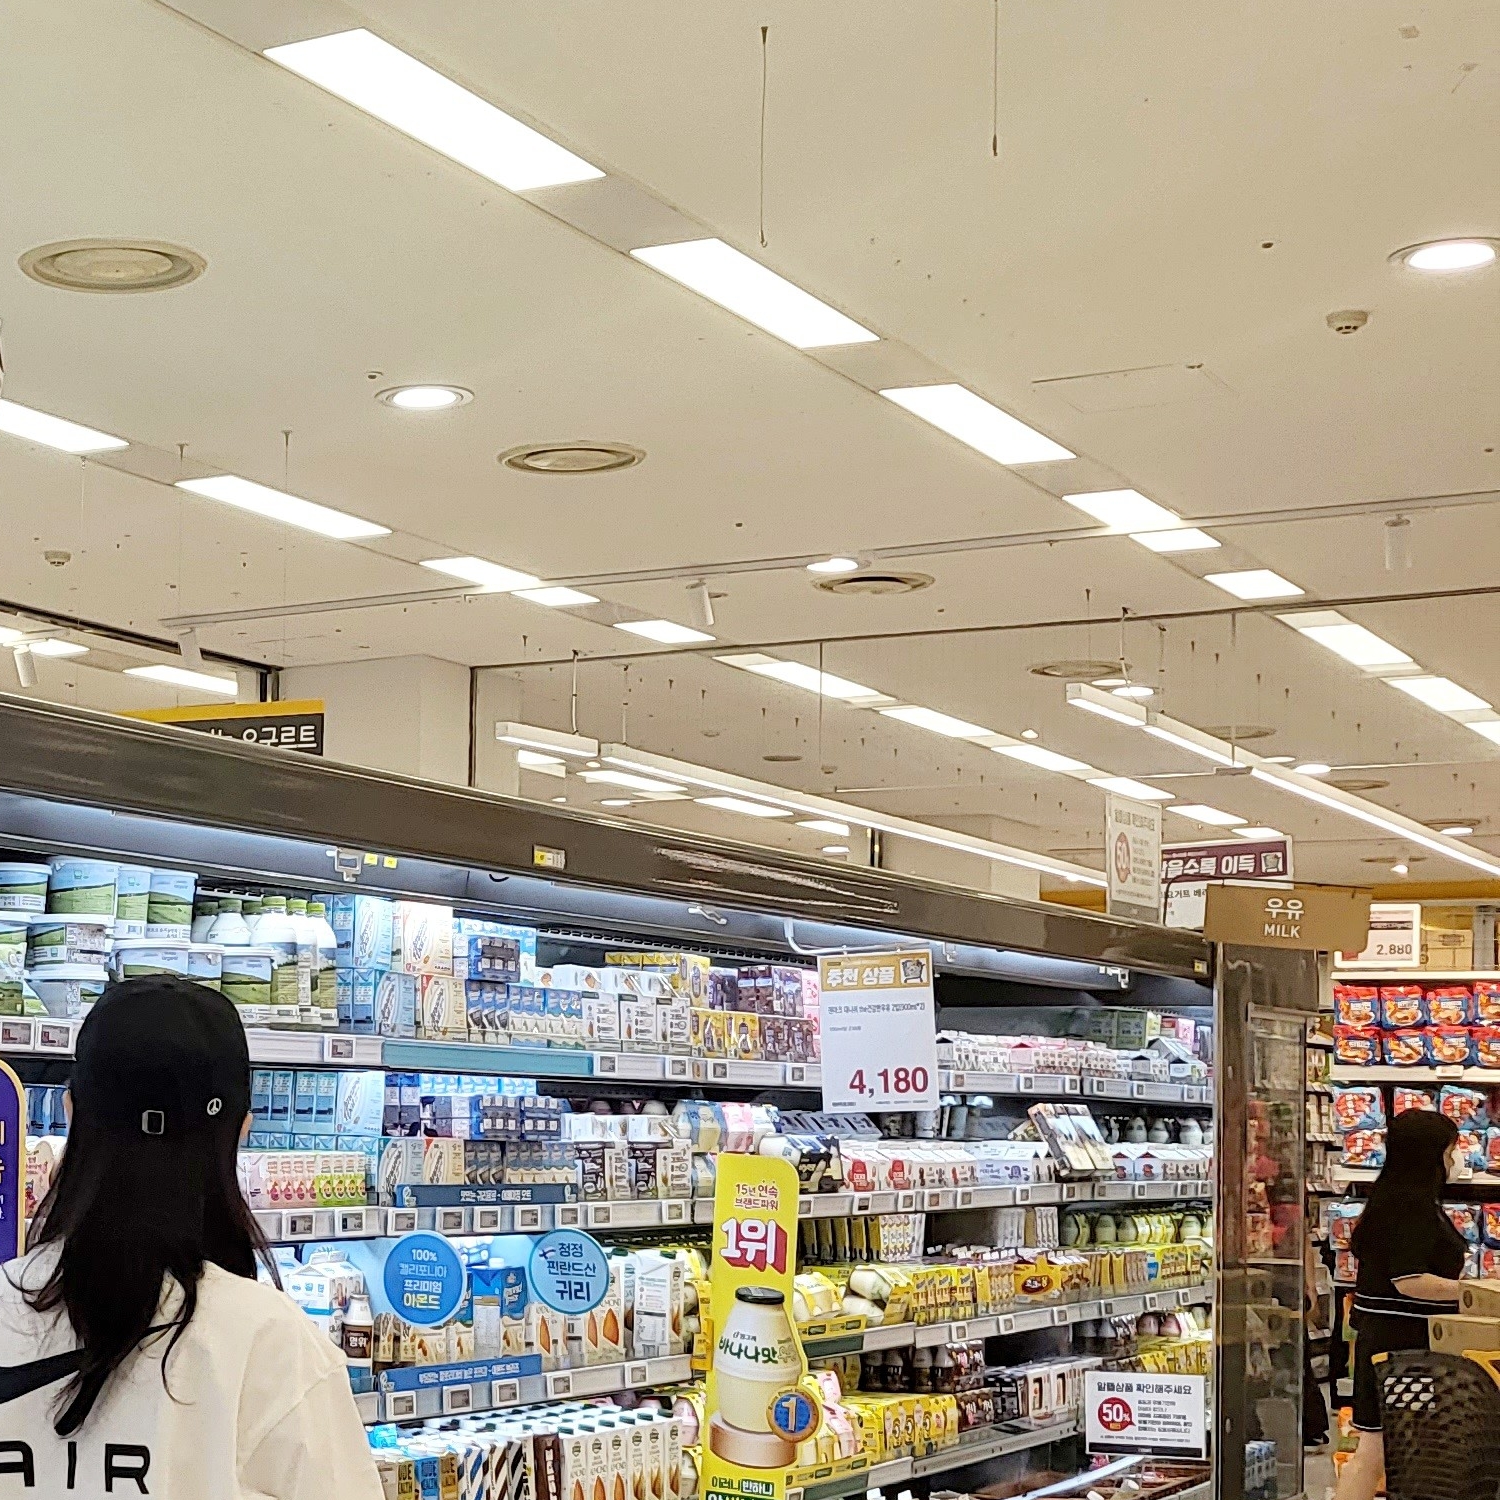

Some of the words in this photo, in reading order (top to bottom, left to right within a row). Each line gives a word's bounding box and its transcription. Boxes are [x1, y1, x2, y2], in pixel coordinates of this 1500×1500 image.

[1221, 854, 1256, 876] 이득
[1264, 897, 1305, 921] 우유
[1264, 923, 1300, 938] MILK
[827, 967, 859, 987] 추천
[862, 966, 895, 985] 상품
[849, 1066, 929, 1098] 4,180
[735, 1184, 756, 1197] 15년
[758, 1183, 779, 1199] 연속
[734, 1197, 779, 1212] 브랜드파워
[558, 1242, 584, 1258] 청정
[720, 1217, 782, 1268] 1위
[411, 1249, 438, 1262] 100%
[547, 1260, 597, 1278] 핀란드산
[403, 1278, 443, 1294] 프리미엄
[555, 1280, 591, 1302] 귀리
[403, 1293, 441, 1310] 아몬드
[718, 1335, 779, 1365] 바나나맛
[781, 1397, 798, 1432] 1
[1102, 1403, 1131, 1422] 50%
[711, 1475, 740, 1491] 이러니
